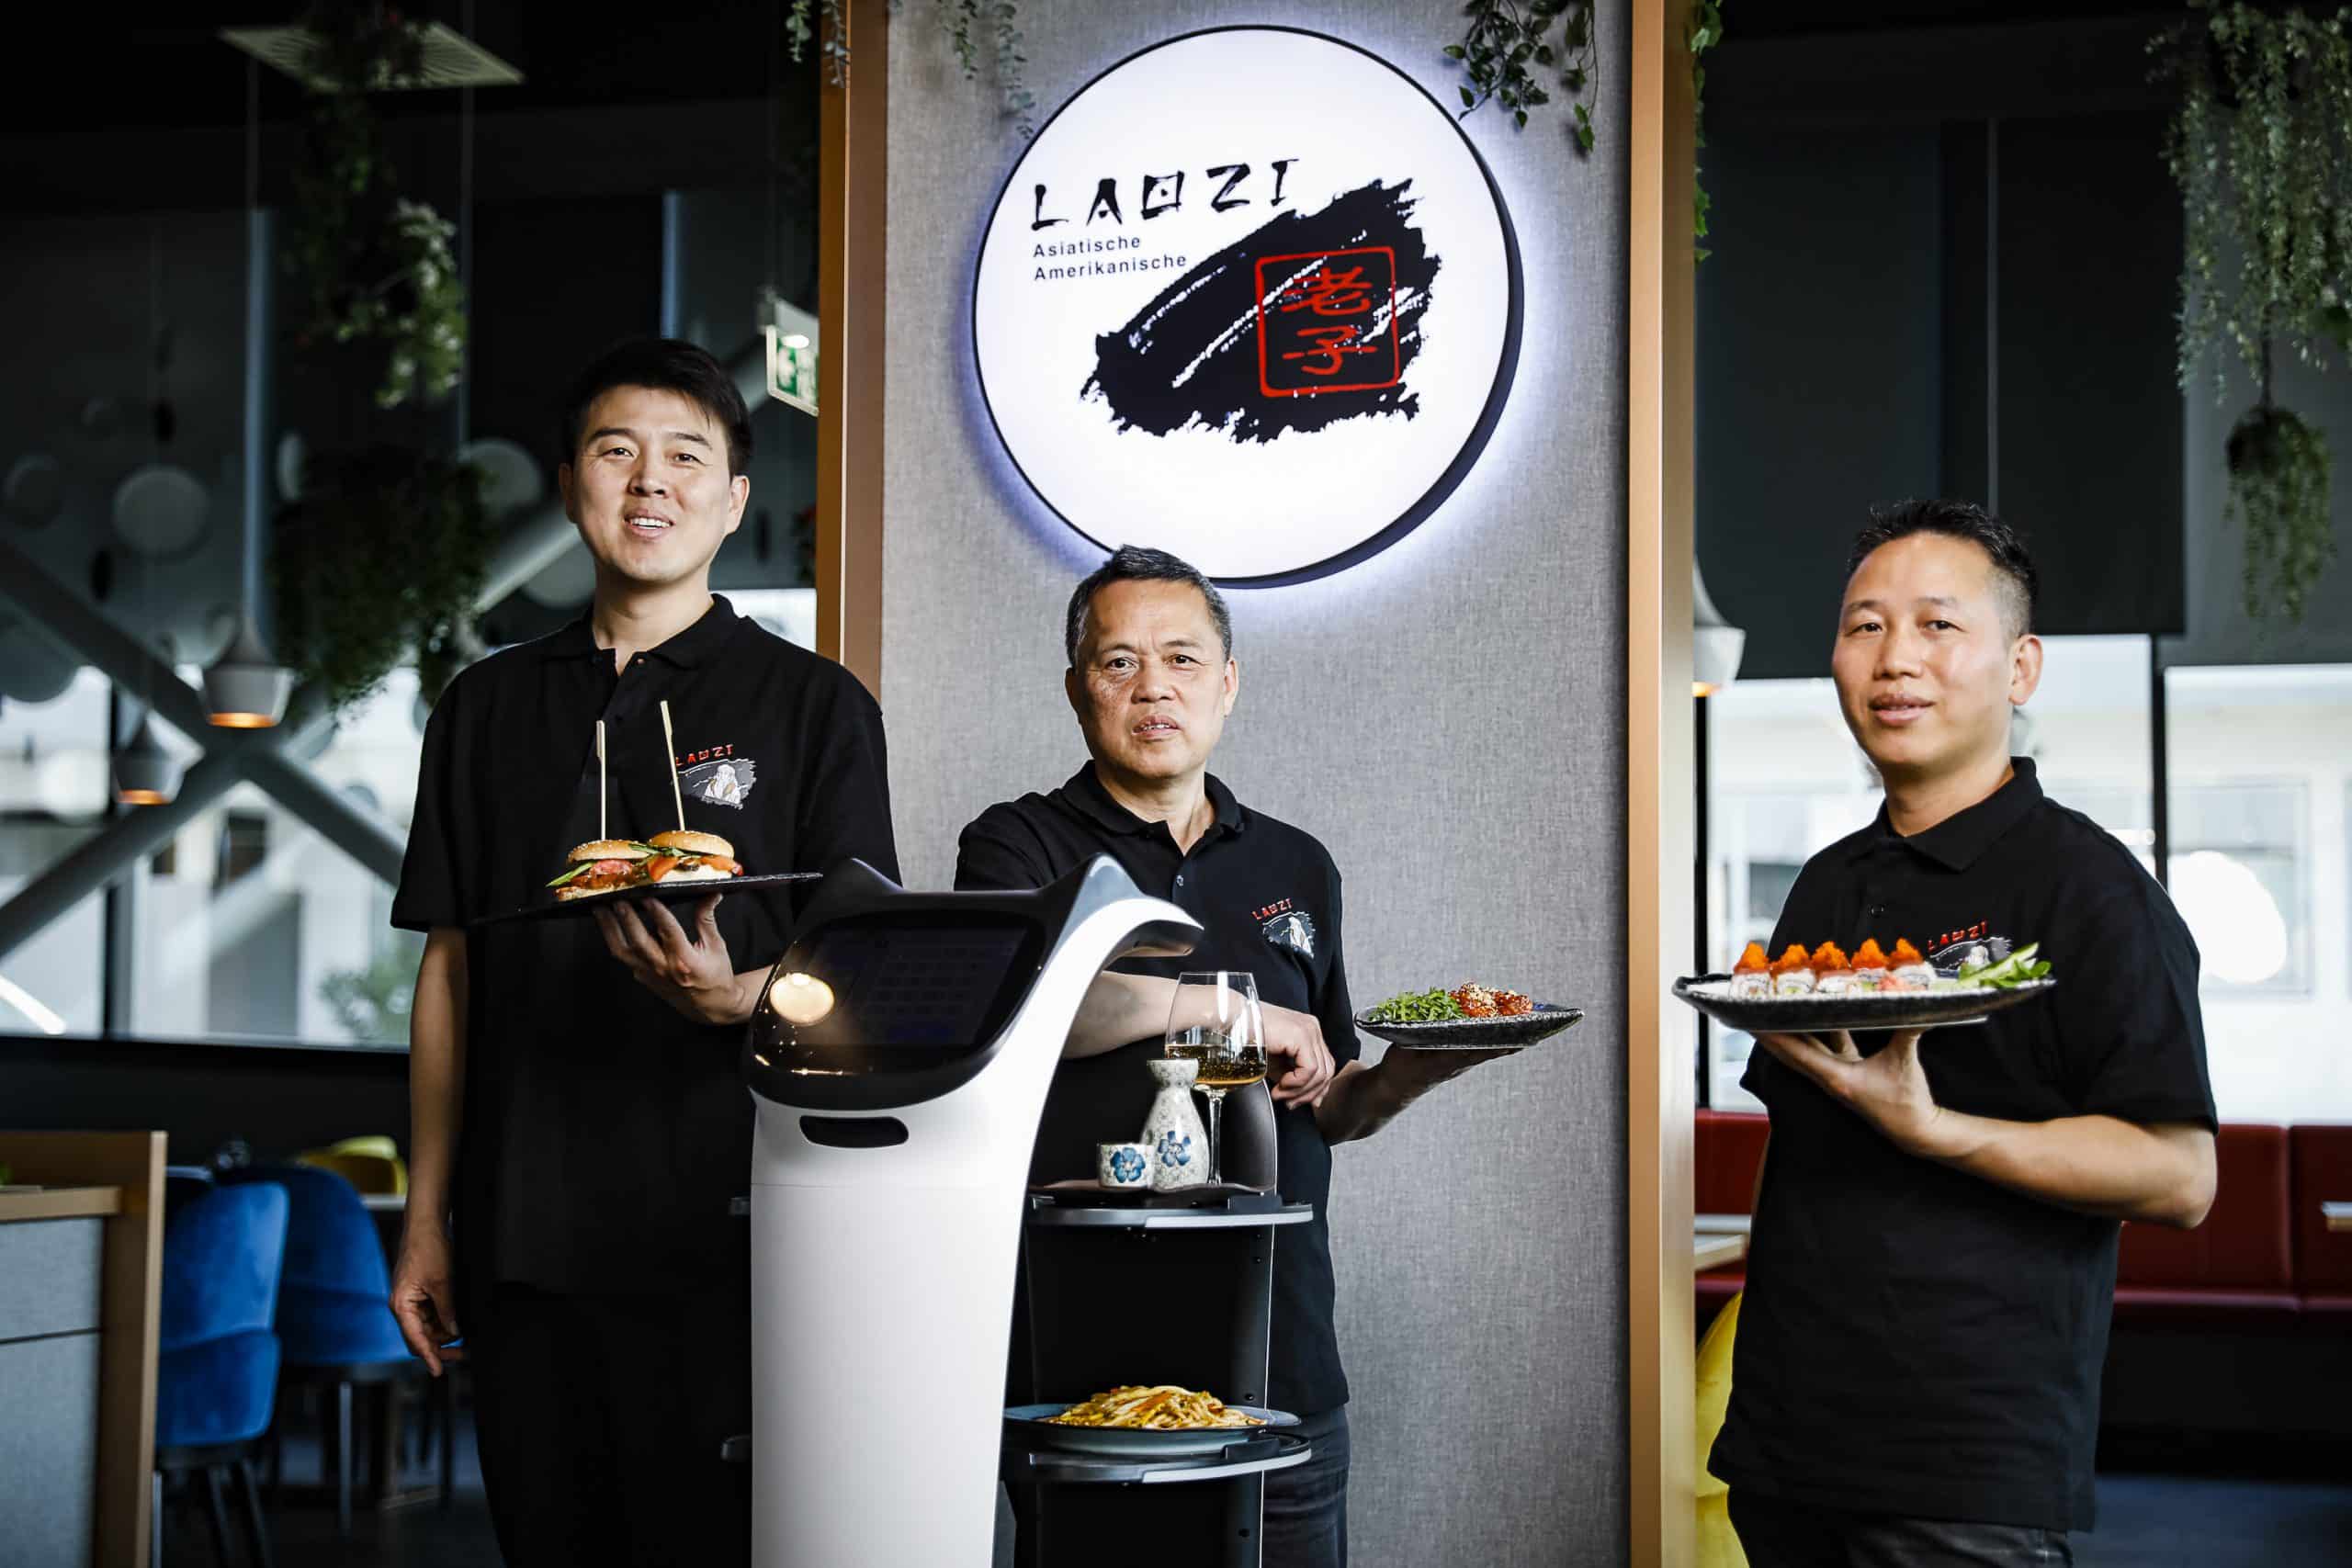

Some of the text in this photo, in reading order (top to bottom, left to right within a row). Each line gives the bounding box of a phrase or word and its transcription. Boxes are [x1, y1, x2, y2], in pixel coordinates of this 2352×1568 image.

[1031, 158, 1300, 231] LAOZI
[1033, 235, 1142, 258] Asiatische
[1035, 254, 1188, 282] Amerikanische
[675, 743, 734, 767] LAOZI
[1251, 897, 1294, 921] LAOZI
[1928, 919, 1988, 952] LAOZI
